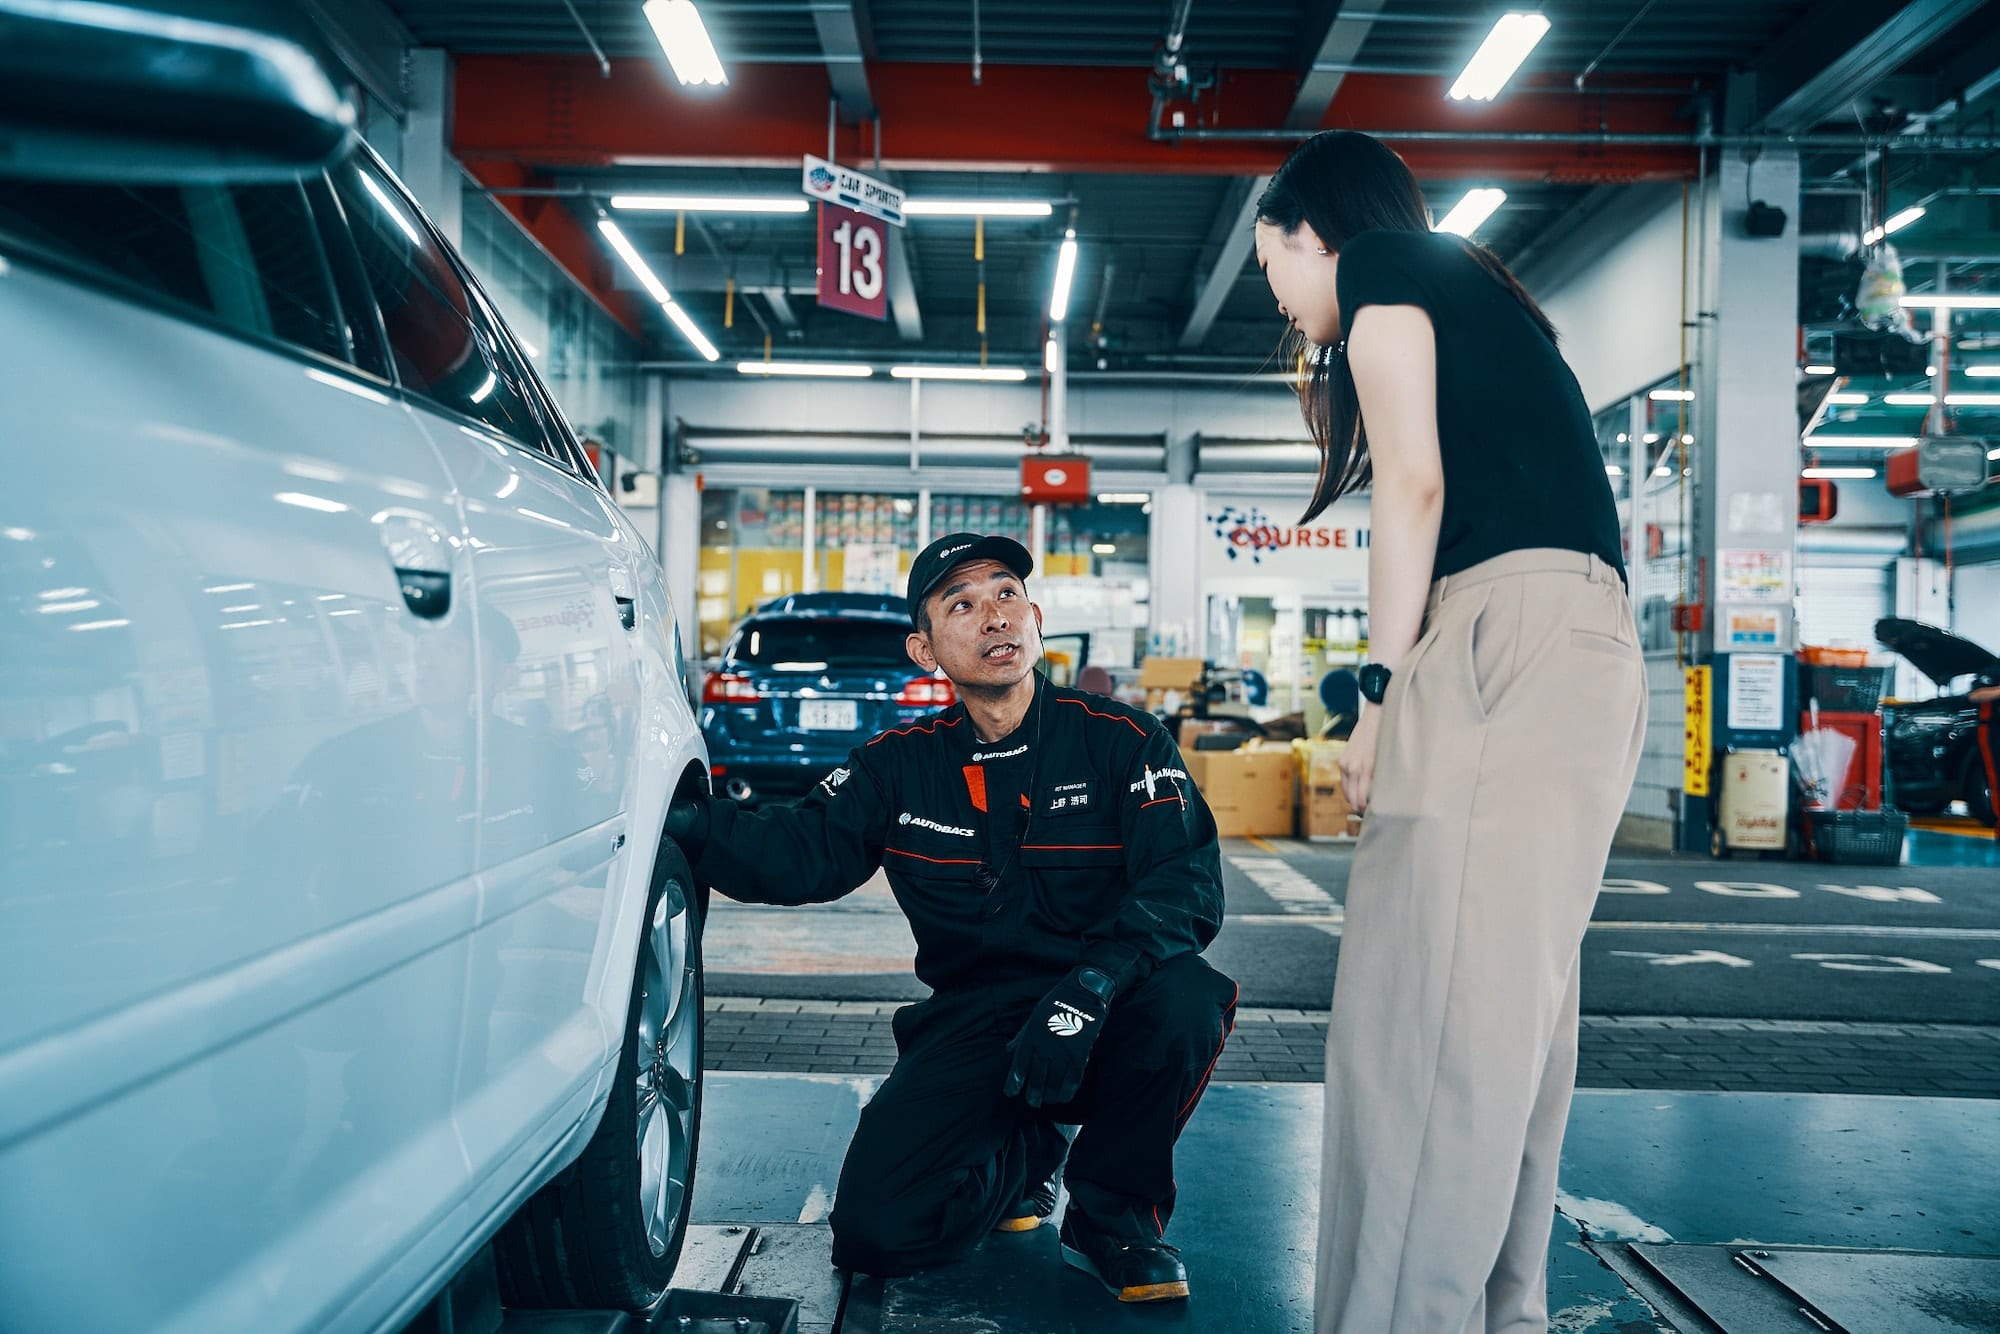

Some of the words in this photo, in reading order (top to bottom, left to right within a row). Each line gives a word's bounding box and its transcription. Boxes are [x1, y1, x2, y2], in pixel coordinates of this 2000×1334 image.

[833, 220, 882, 300] 13
[1231, 525, 1348, 549] COURSE
[982, 744, 1029, 760] AUTOBACS
[909, 816, 976, 837] AUTOBACS
[1053, 1000, 1096, 1022] AUTOBACS
